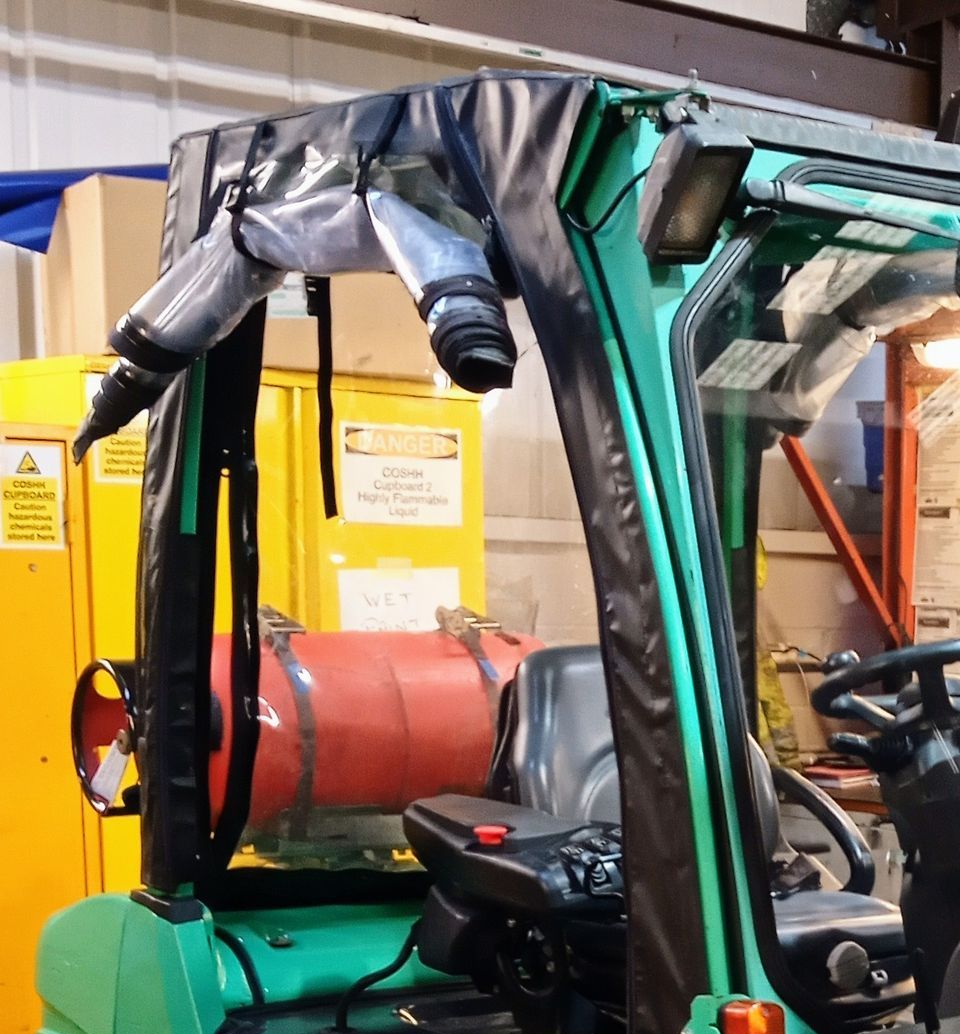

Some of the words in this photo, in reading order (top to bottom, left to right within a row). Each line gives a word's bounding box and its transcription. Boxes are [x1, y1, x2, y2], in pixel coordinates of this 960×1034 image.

[110, 437, 142, 446] Caution
[357, 432, 447, 455] DANGER
[382, 467, 424, 479] COSHH
[12, 480, 46, 489] COSHH
[373, 479, 424, 492] Cupboard
[425, 482, 433, 492] 2
[3, 490, 56, 501] CUPBOARD
[357, 491, 390, 505] Highly
[392, 492, 449, 505] Flammable
[14, 502, 47, 511] Caution
[388, 506, 419, 518] Liquid
[8, 512, 53, 521] hazardous
[9, 522, 53, 532] chemicals
[7, 533, 35, 541] stored
[37, 533, 55, 542] here
[362, 592, 413, 608] WET
